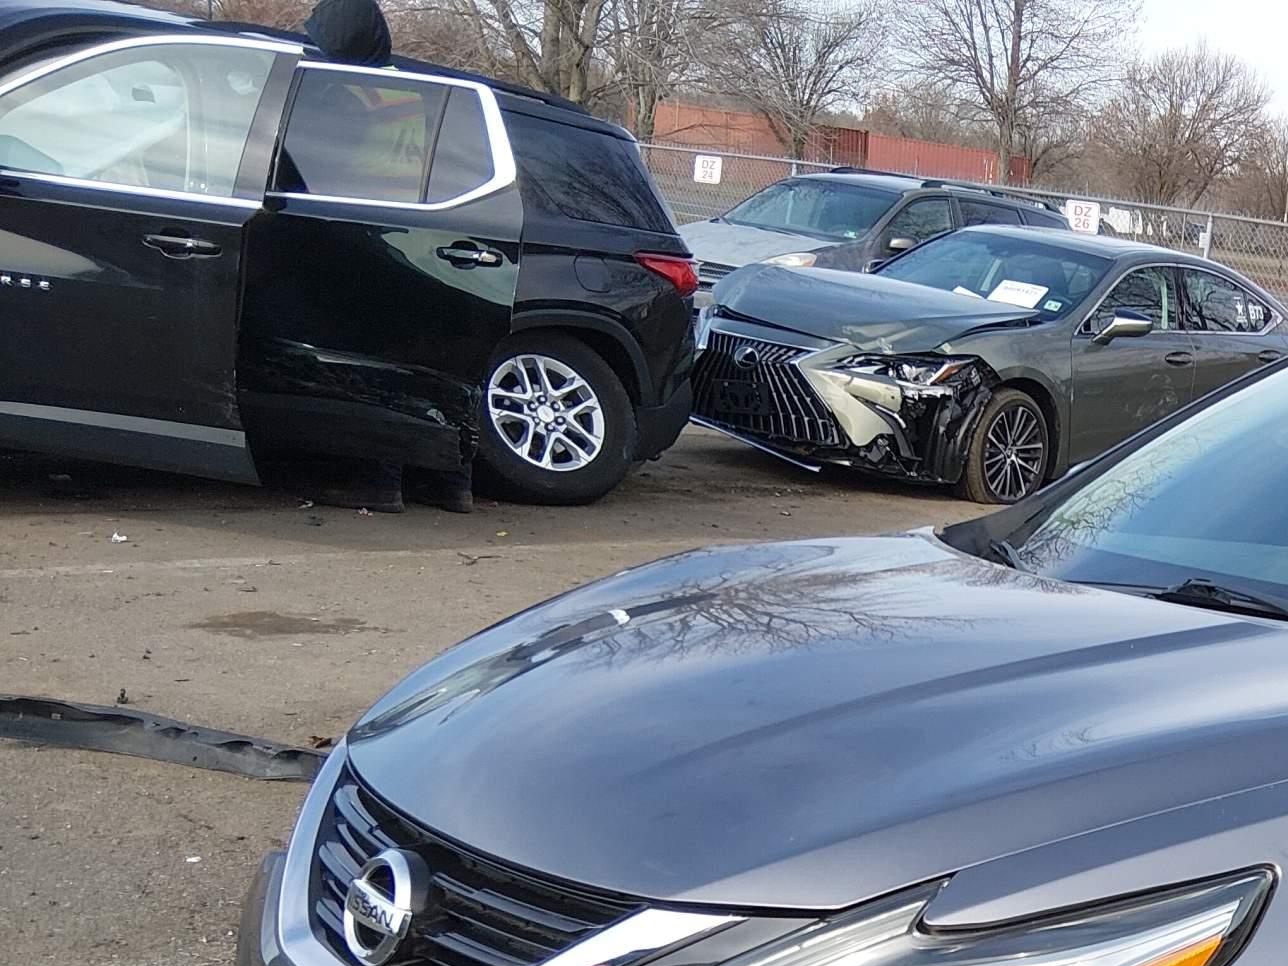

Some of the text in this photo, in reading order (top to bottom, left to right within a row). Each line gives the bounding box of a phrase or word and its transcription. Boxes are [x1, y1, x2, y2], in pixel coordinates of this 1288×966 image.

[702, 160, 716, 170] DZ
[1074, 205, 1092, 217] DZ
[1074, 217, 1090, 229] 26
